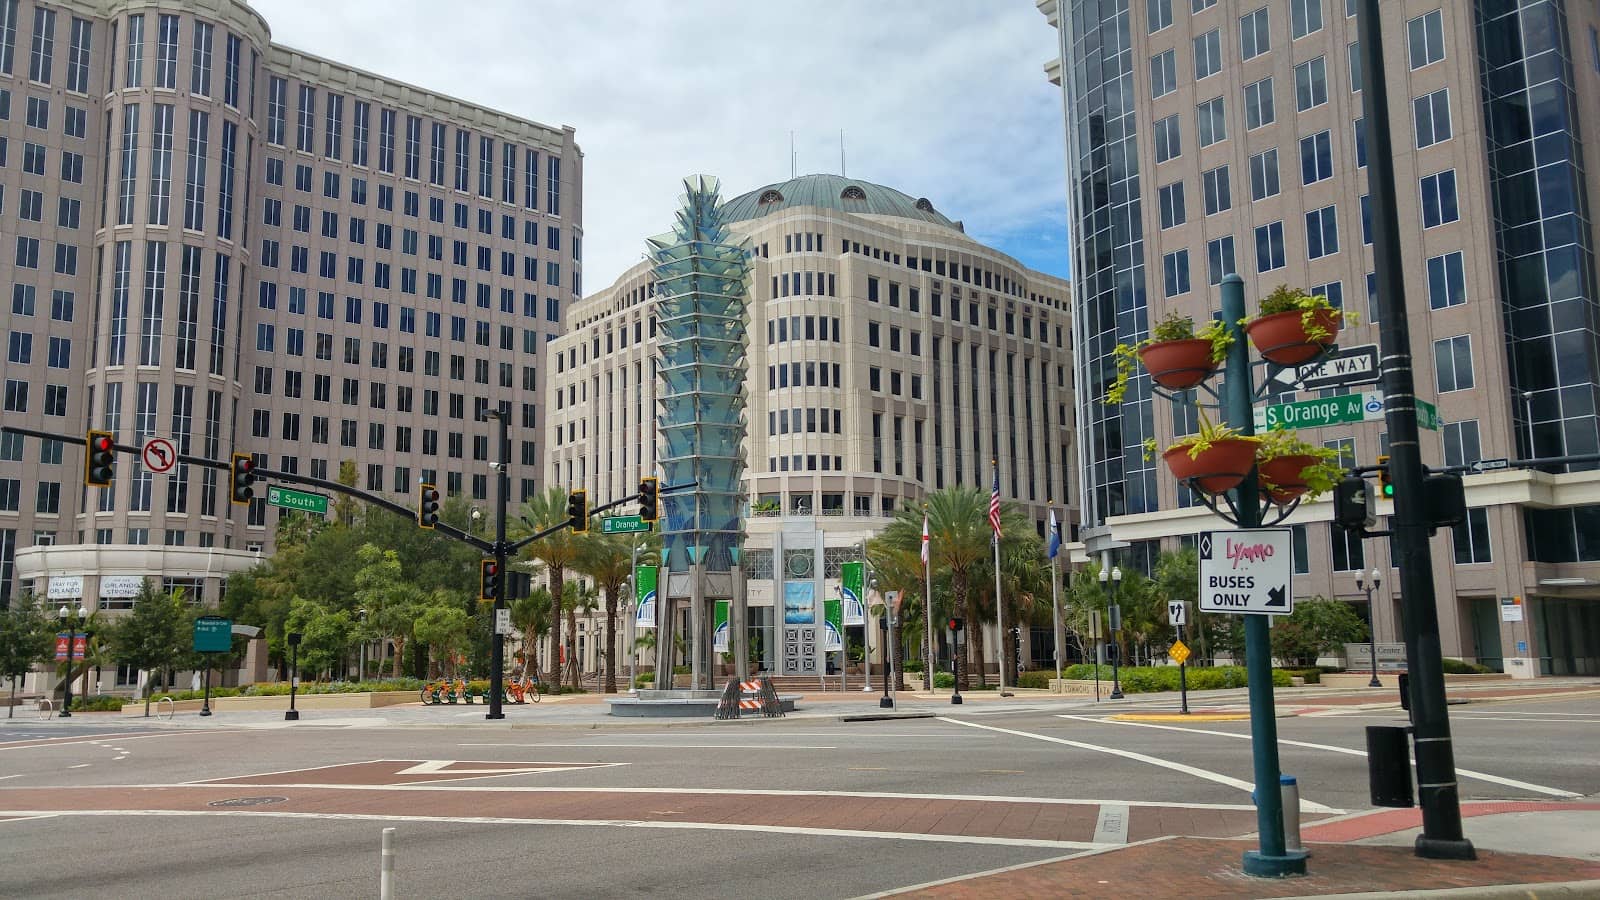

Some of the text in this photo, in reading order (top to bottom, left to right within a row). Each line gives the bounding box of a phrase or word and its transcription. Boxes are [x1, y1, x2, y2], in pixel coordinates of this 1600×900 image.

[1301, 357, 1369, 379] ONE WAY
[1268, 402, 1361, 425] S Orange Av
[285, 494, 315, 508] South
[615, 520, 639, 530] Orange
[1209, 575, 1255, 589] BUSES
[1213, 593, 1251, 607] ONLY
